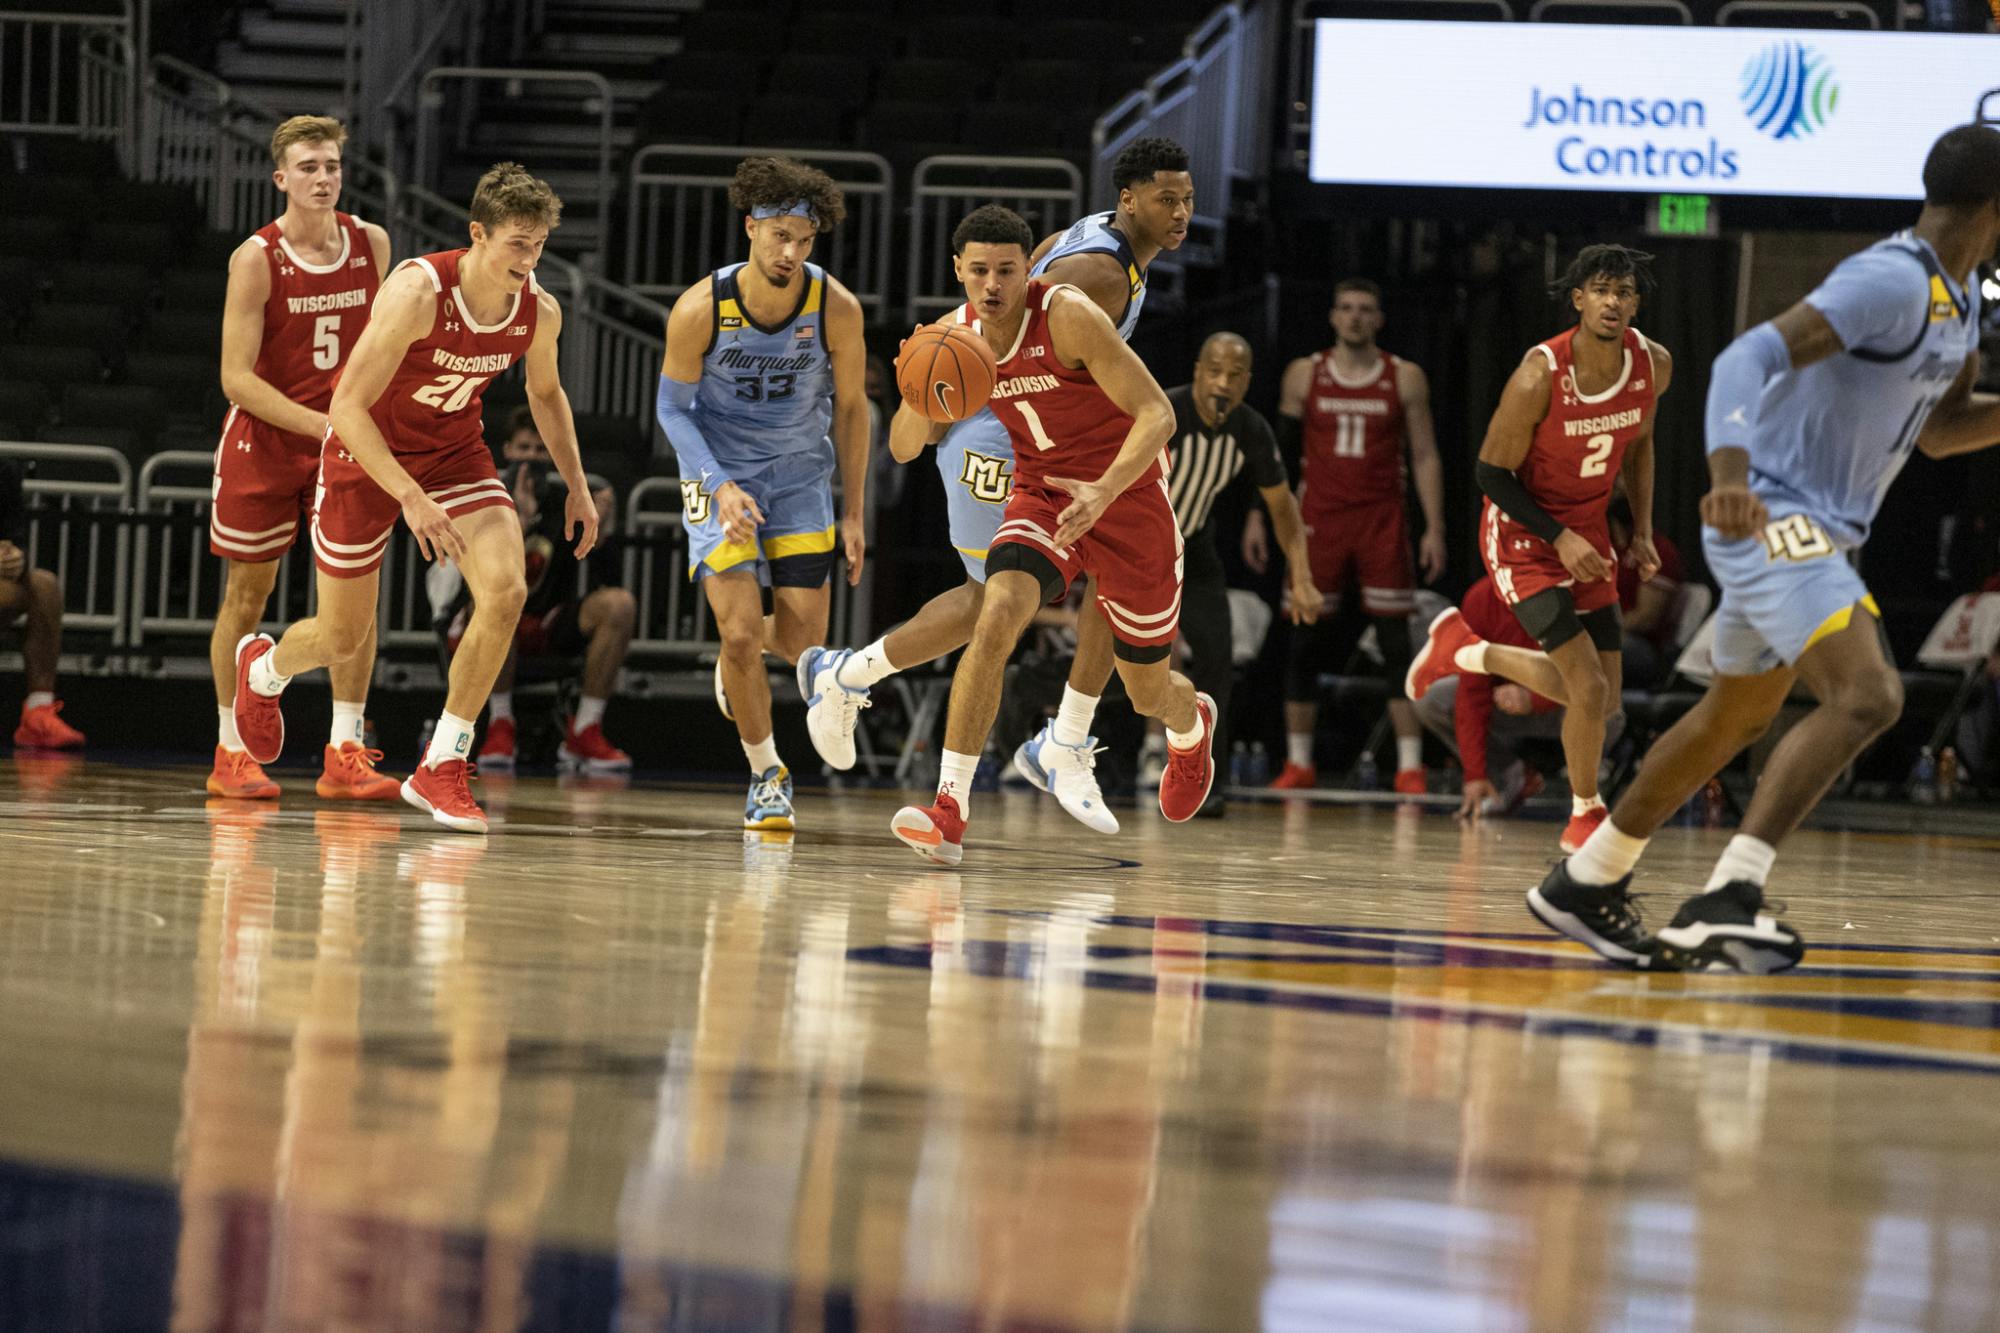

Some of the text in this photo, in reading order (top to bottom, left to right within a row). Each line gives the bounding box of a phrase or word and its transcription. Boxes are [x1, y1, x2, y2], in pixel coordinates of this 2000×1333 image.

[1523, 84, 1706, 129] Johnson
[1555, 136, 1740, 179] Controls
[287, 288, 367, 314] WISCONSIN
[313, 315, 341, 371] 5
[432, 348, 512, 373] WISCONSIN
[718, 348, 816, 376] Marquette
[411, 374, 489, 413] 20
[991, 374, 1060, 398] SCONSIN
[1013, 400, 1056, 451] 1
[1334, 414, 1366, 458] 11
[1563, 407, 1642, 437] WISCONSIN
[959, 448, 1013, 504] MU
[1579, 433, 1614, 478] 2
